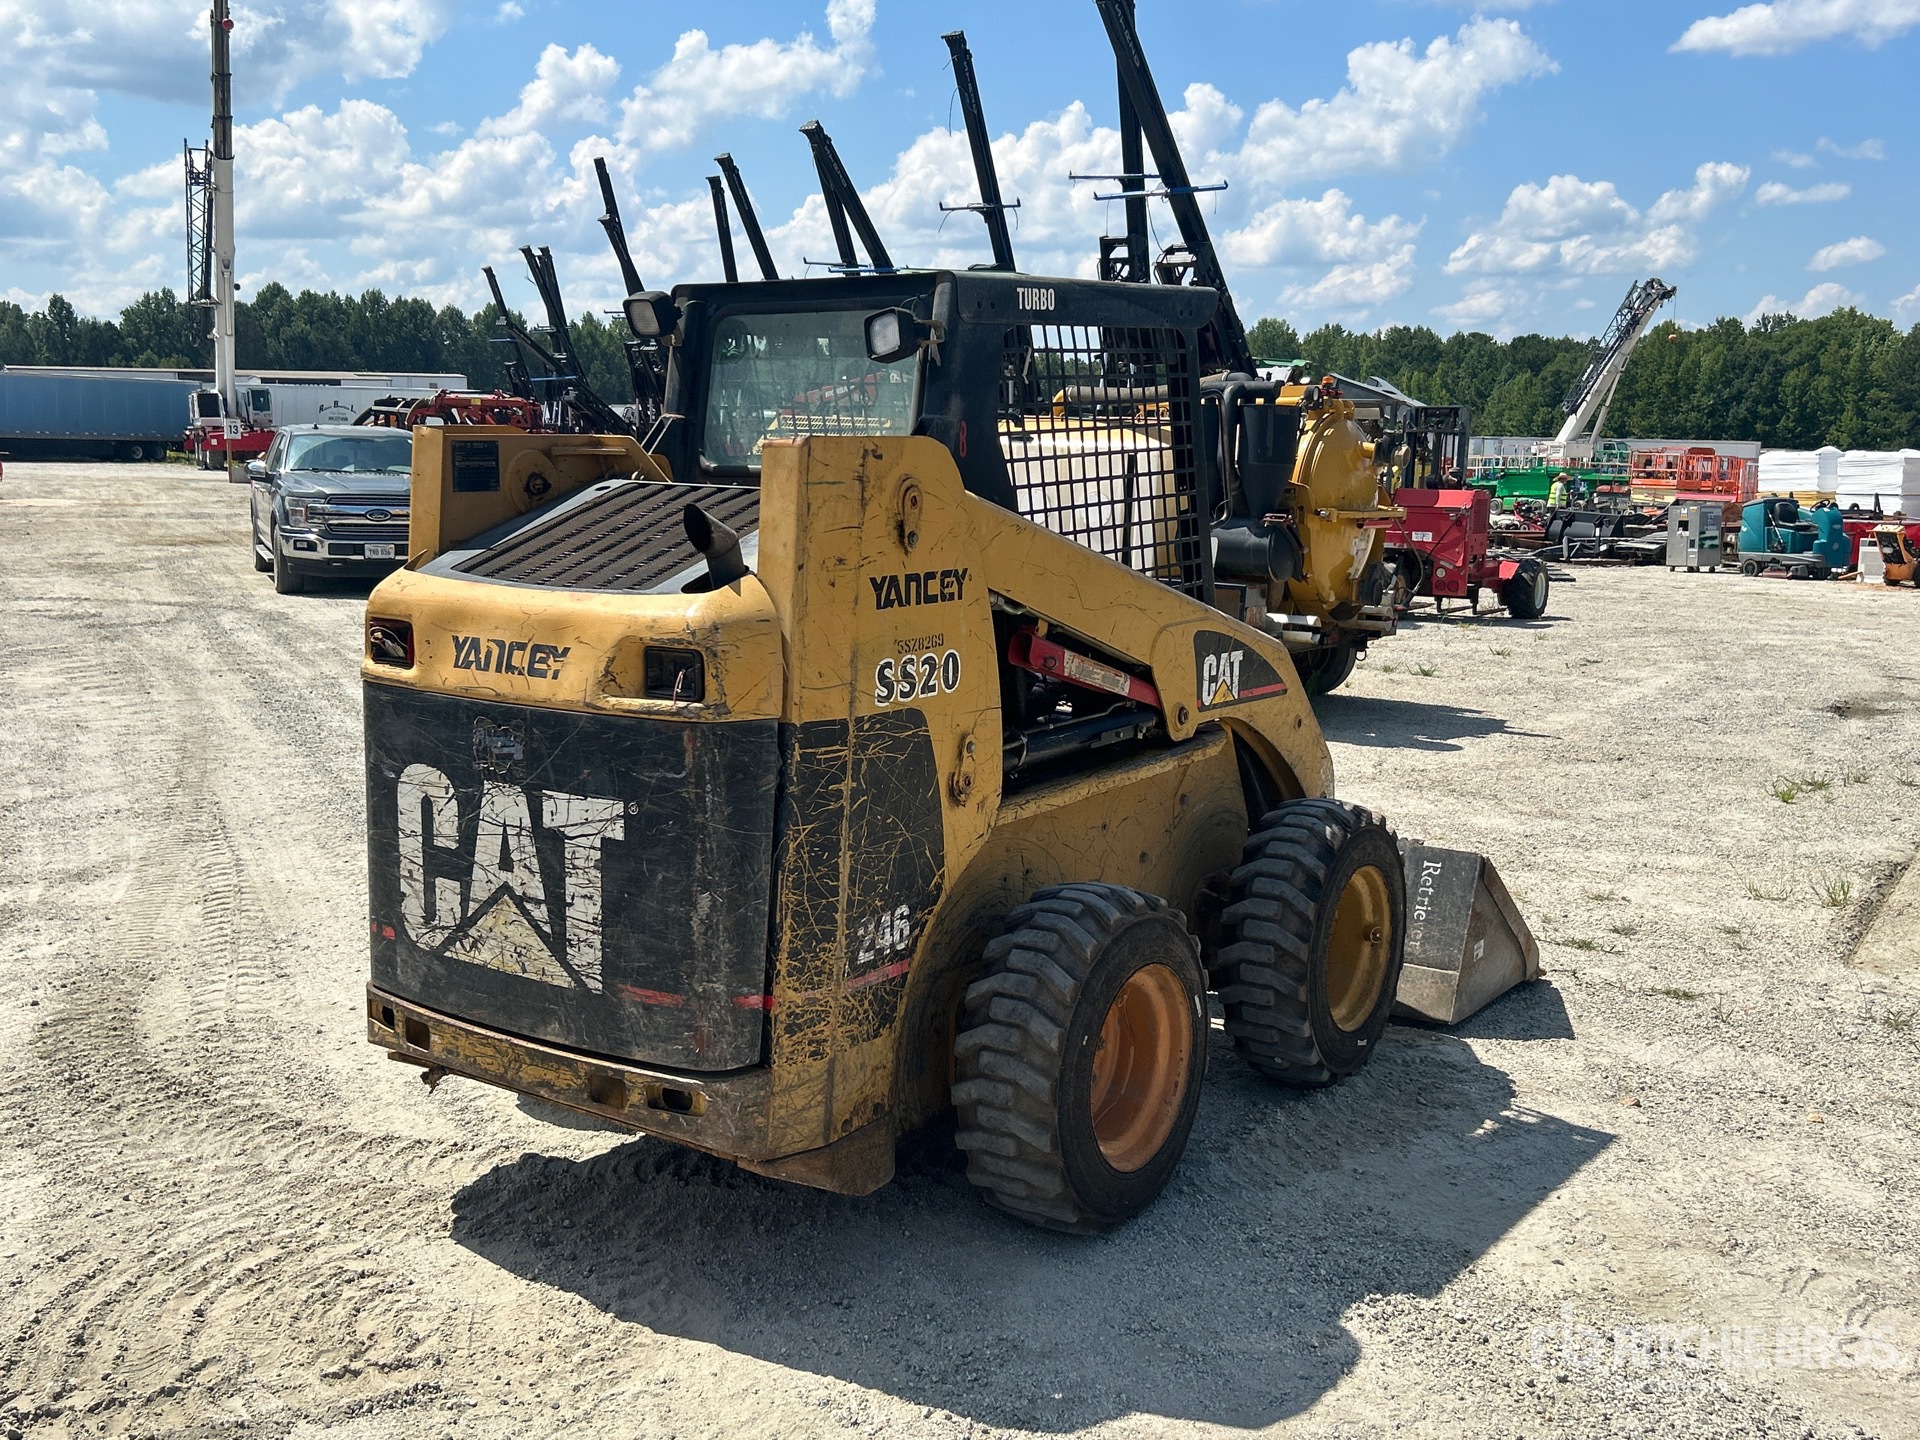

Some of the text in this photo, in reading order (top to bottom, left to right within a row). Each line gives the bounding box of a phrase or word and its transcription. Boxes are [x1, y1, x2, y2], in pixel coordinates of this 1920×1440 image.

[1016, 287, 1055, 311] TURBO
[228, 425, 239, 435] 13
[869, 567, 969, 610] YANCEY
[451, 634, 572, 680] YANCEY
[874, 648, 961, 707] SS20
[1202, 650, 1244, 706] CAT
[397, 763, 626, 994] CAT
[856, 904, 911, 965] 246
